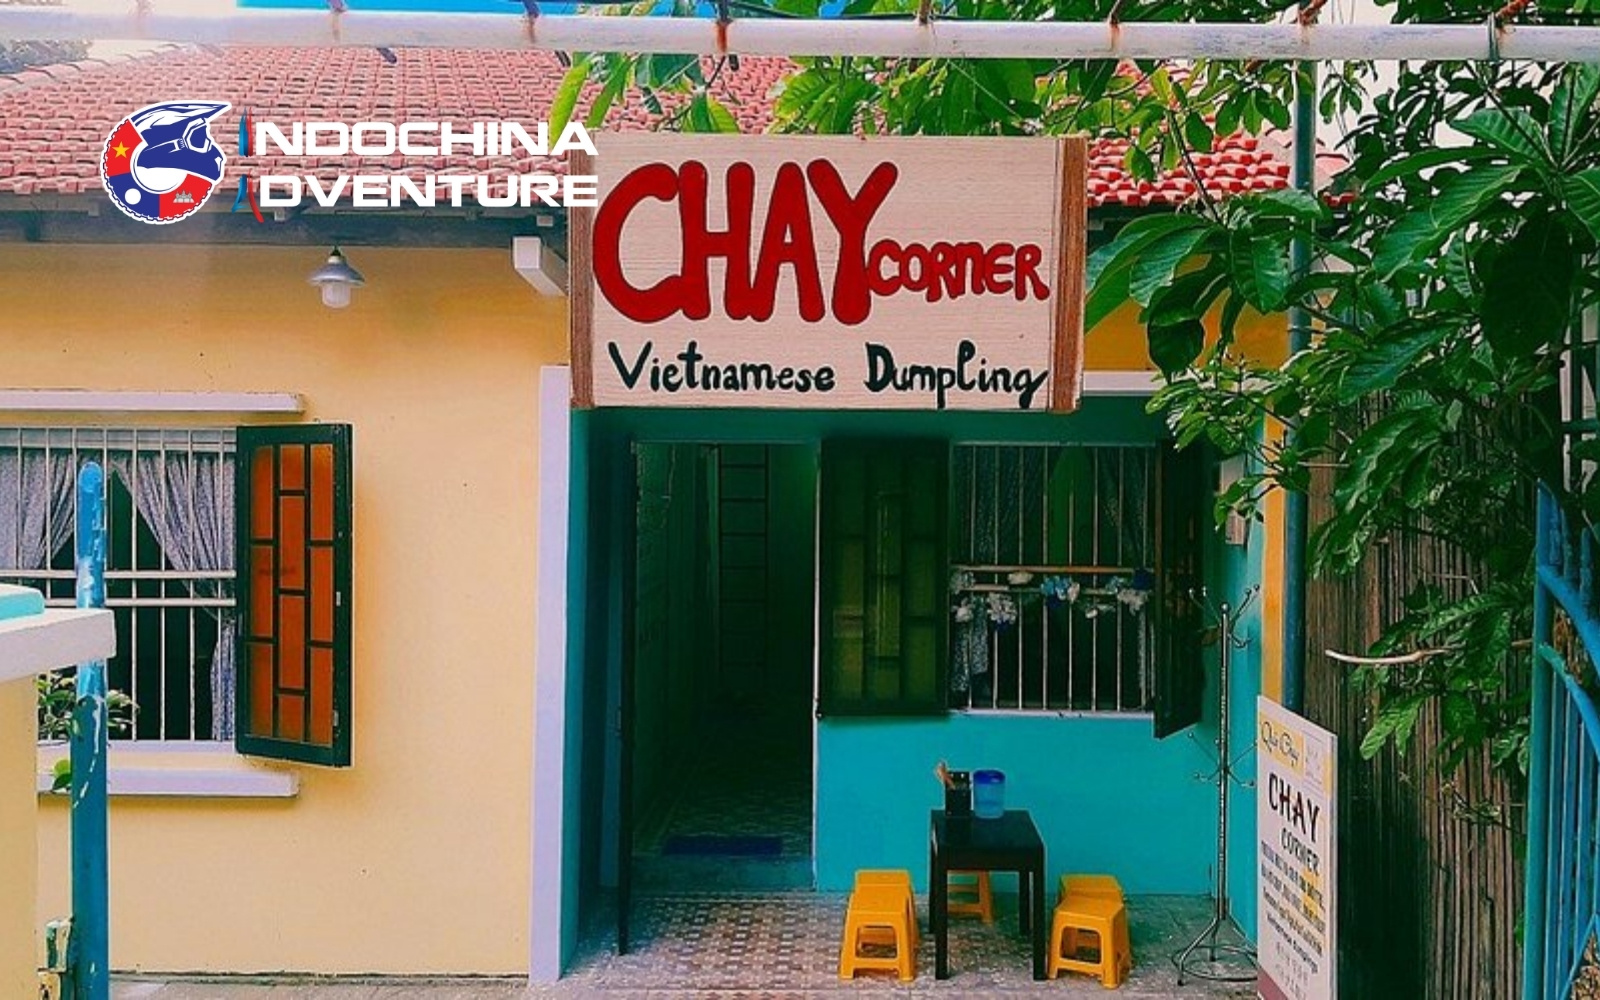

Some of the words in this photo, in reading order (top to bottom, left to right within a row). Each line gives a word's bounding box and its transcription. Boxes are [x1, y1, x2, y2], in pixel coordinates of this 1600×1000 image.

[592, 158, 898, 326] CHAY
[866, 239, 1050, 301] CORNER
[608, 341, 835, 392] Vietnamese
[864, 340, 1048, 409] Dumpling
[1268, 772, 1320, 843] CHAY
[1281, 827, 1320, 877] CORNER
